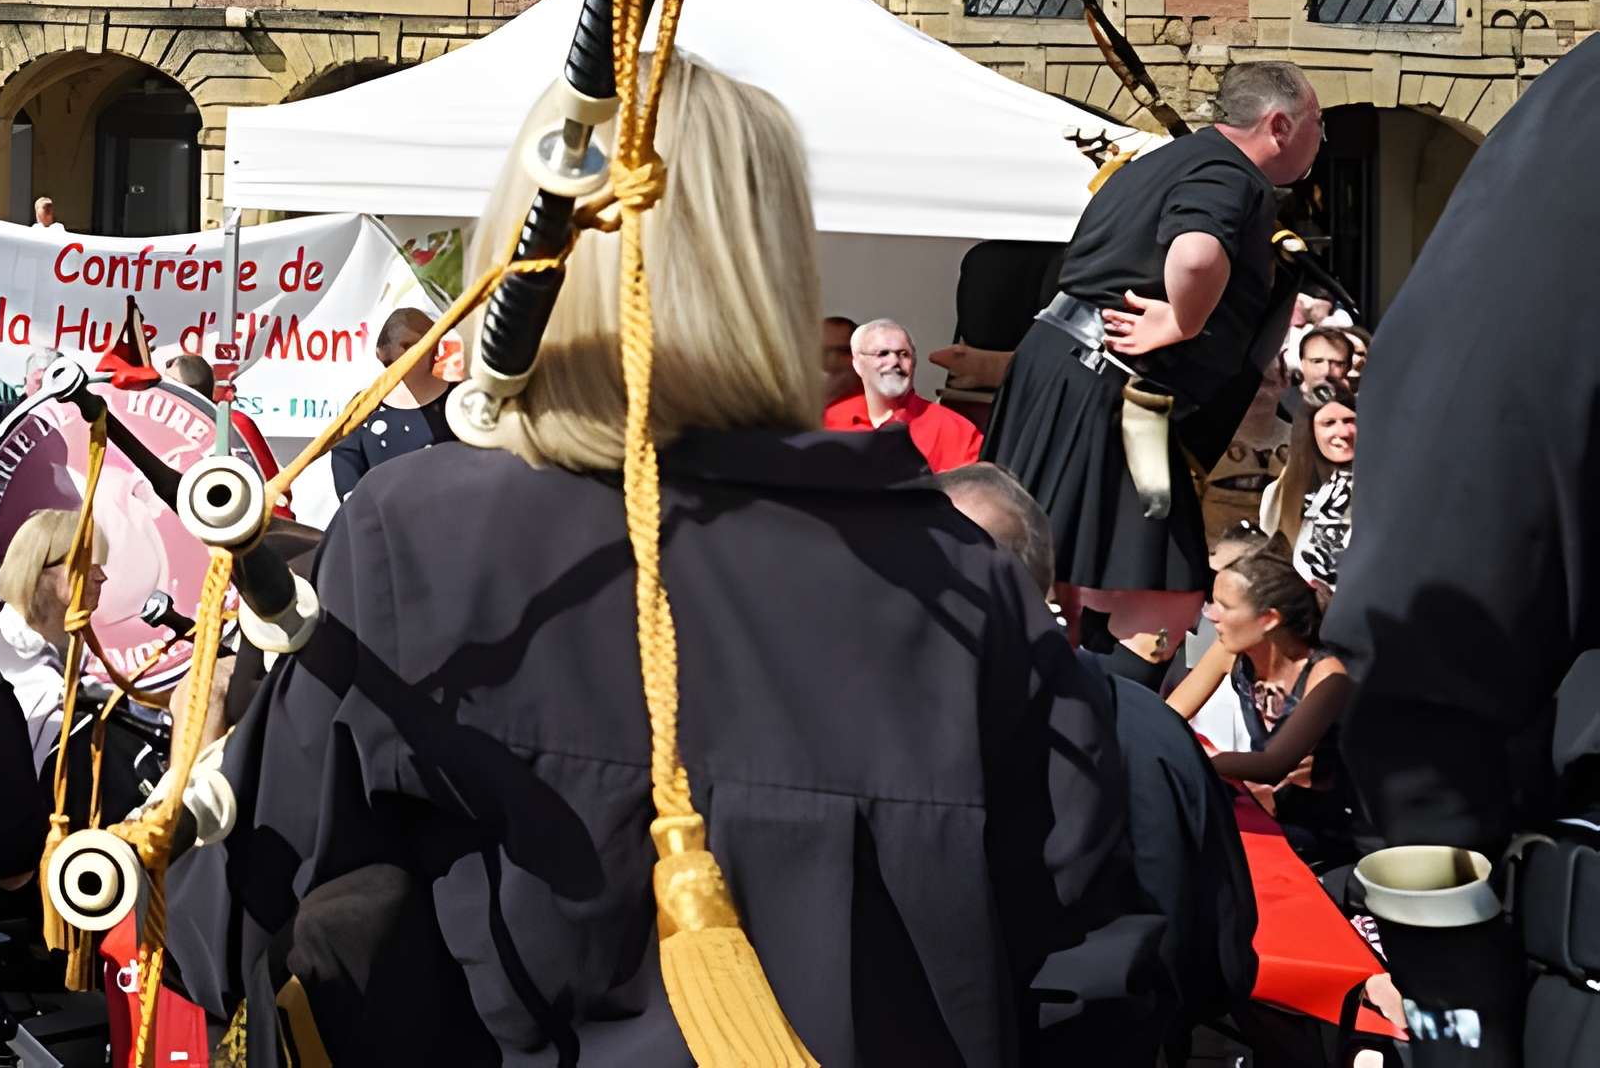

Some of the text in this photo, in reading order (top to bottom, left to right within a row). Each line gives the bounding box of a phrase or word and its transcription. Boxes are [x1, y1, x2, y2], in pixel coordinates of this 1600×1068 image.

[54, 243, 324, 292] Confrére de
[55, 305, 157, 353] Hue
